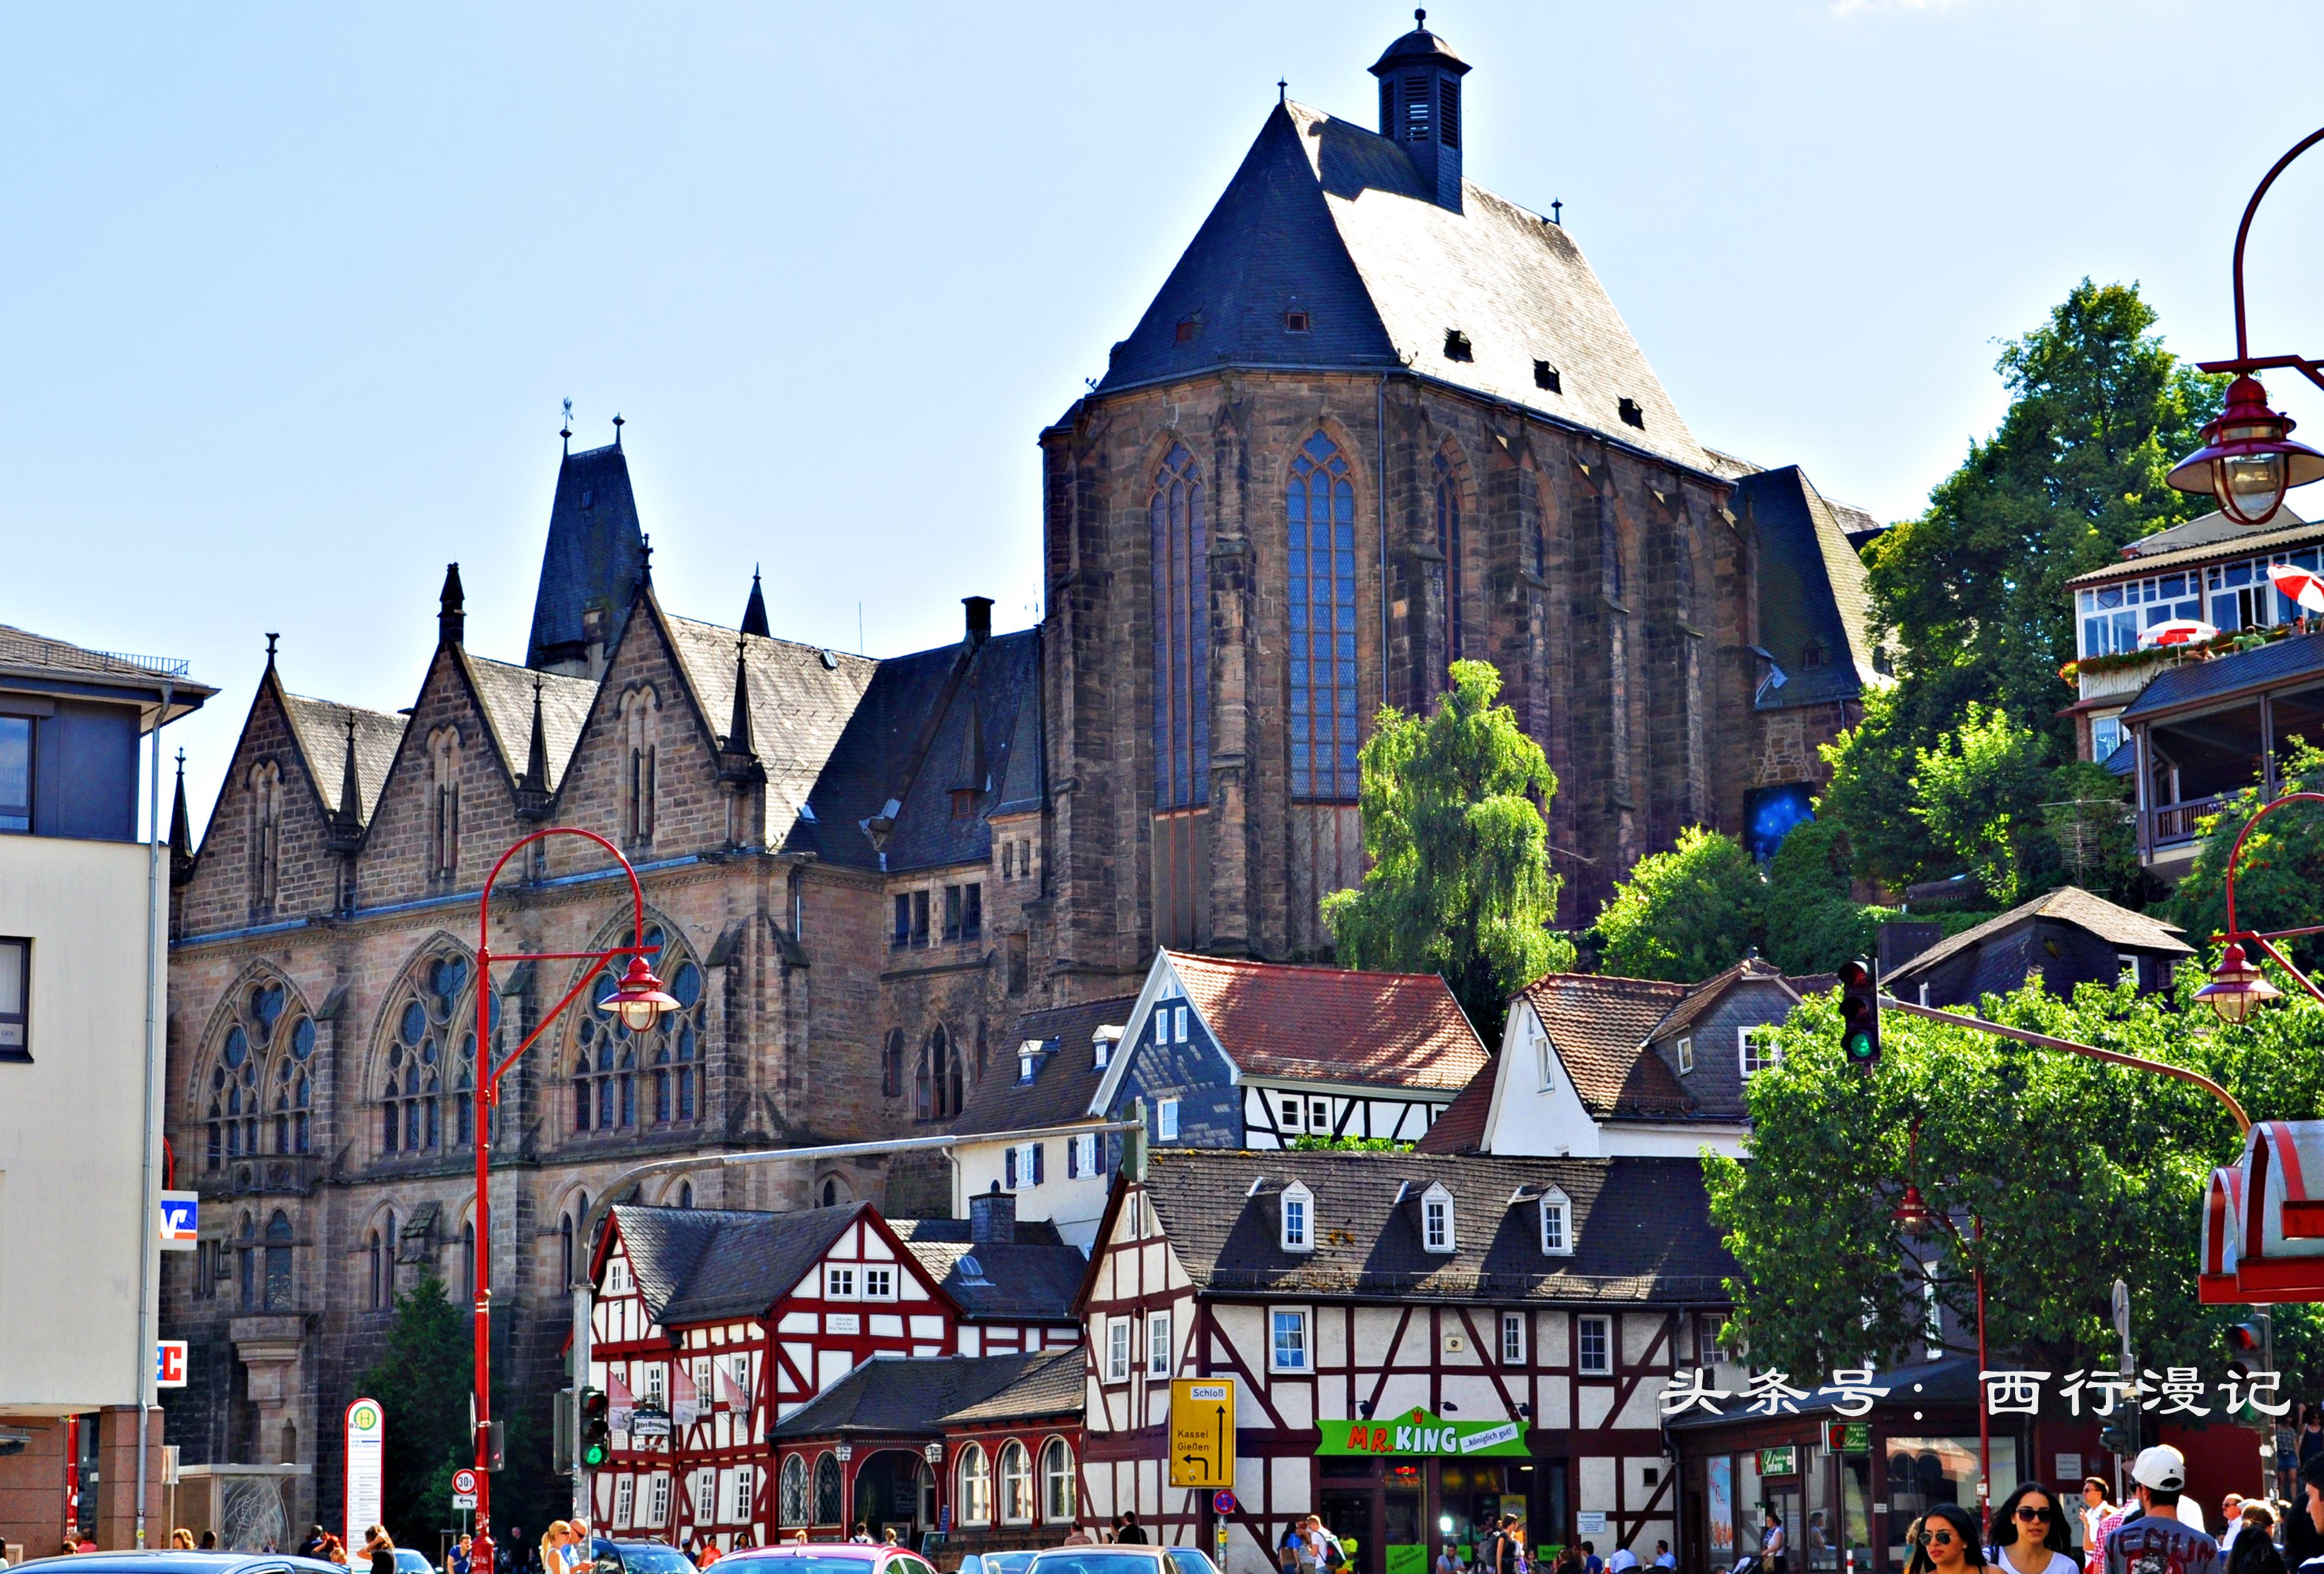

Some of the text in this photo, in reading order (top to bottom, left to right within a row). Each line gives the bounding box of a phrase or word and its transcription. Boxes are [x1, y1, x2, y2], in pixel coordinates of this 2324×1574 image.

[1193, 1388, 1224, 1397] Schloß
[1178, 1430, 1209, 1438] Kassel
[1499, 1427, 1512, 1440] gut!
[1178, 1442, 1209, 1451] Gießen
